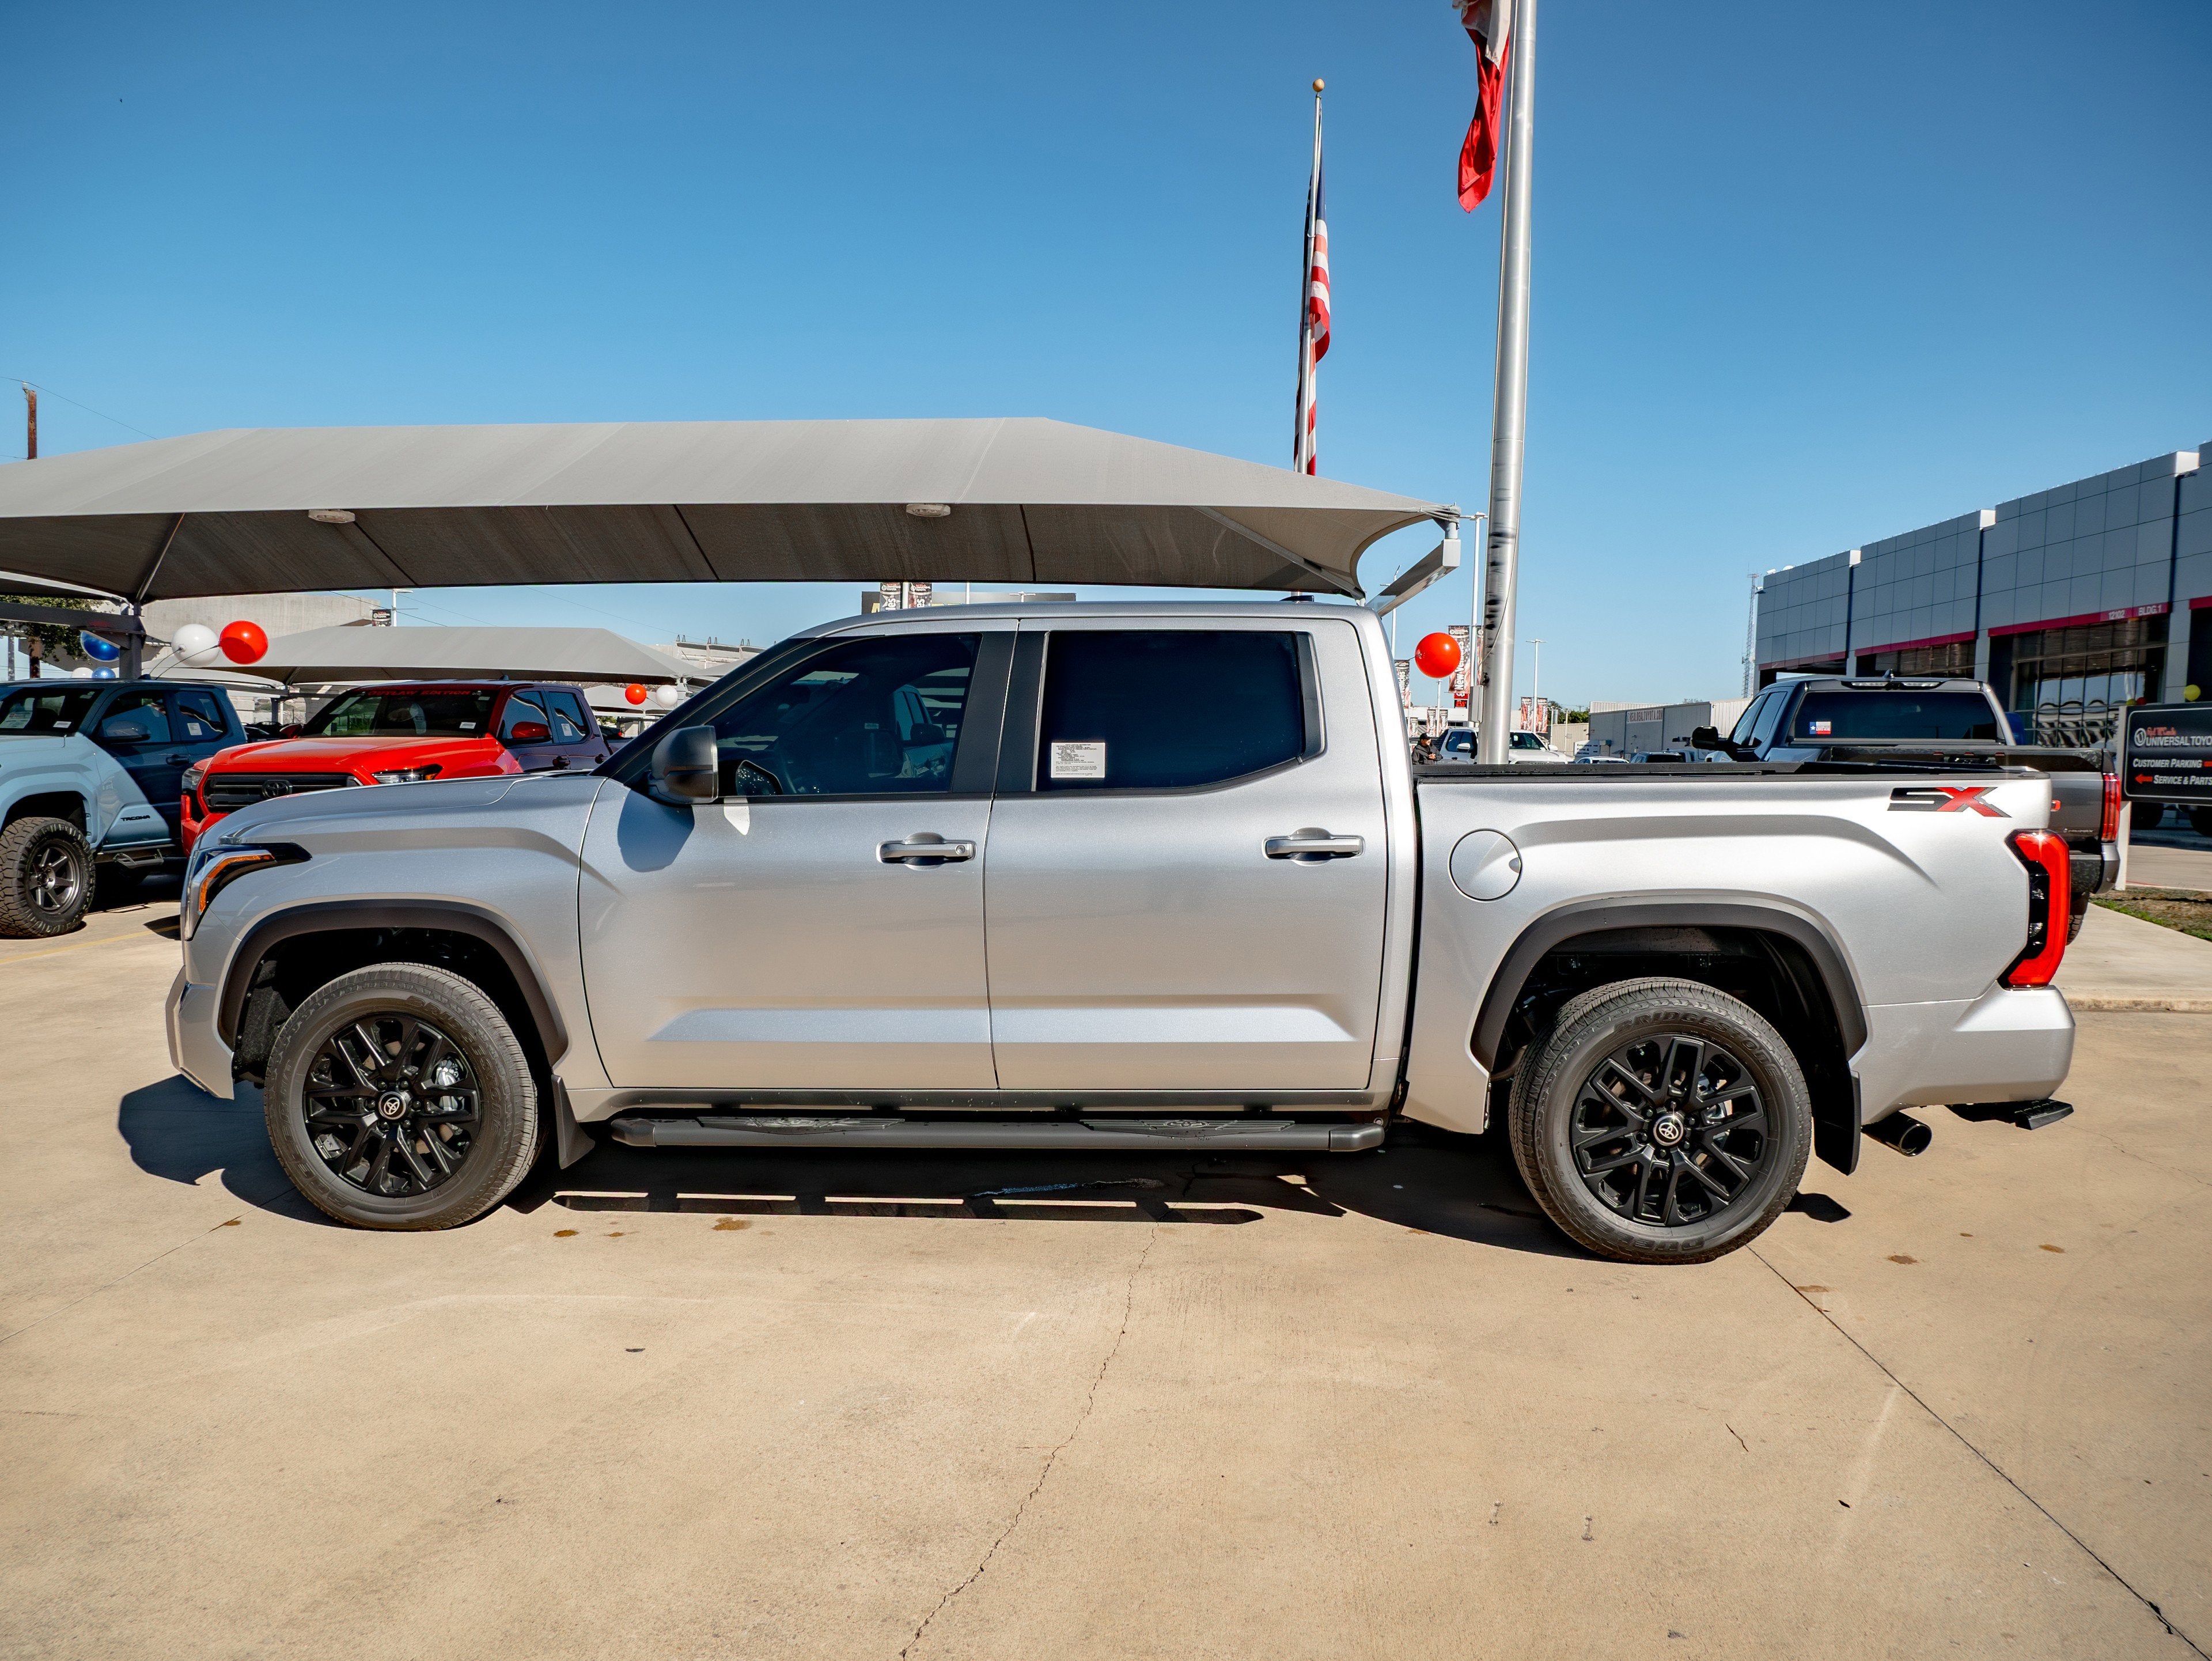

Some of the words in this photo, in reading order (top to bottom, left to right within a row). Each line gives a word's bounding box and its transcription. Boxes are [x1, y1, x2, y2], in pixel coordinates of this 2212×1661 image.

[1454, 674, 1464, 691] New
[2146, 736, 2190, 746] UNIVERSAL
[2133, 758, 2169, 767] CUSTOMER
[2170, 759, 2203, 768] PARKING
[2153, 775, 2182, 784] SERVICE
[2183, 776, 2189, 785] &
[1613, 1011, 1780, 1079] BRIDGESTONE
